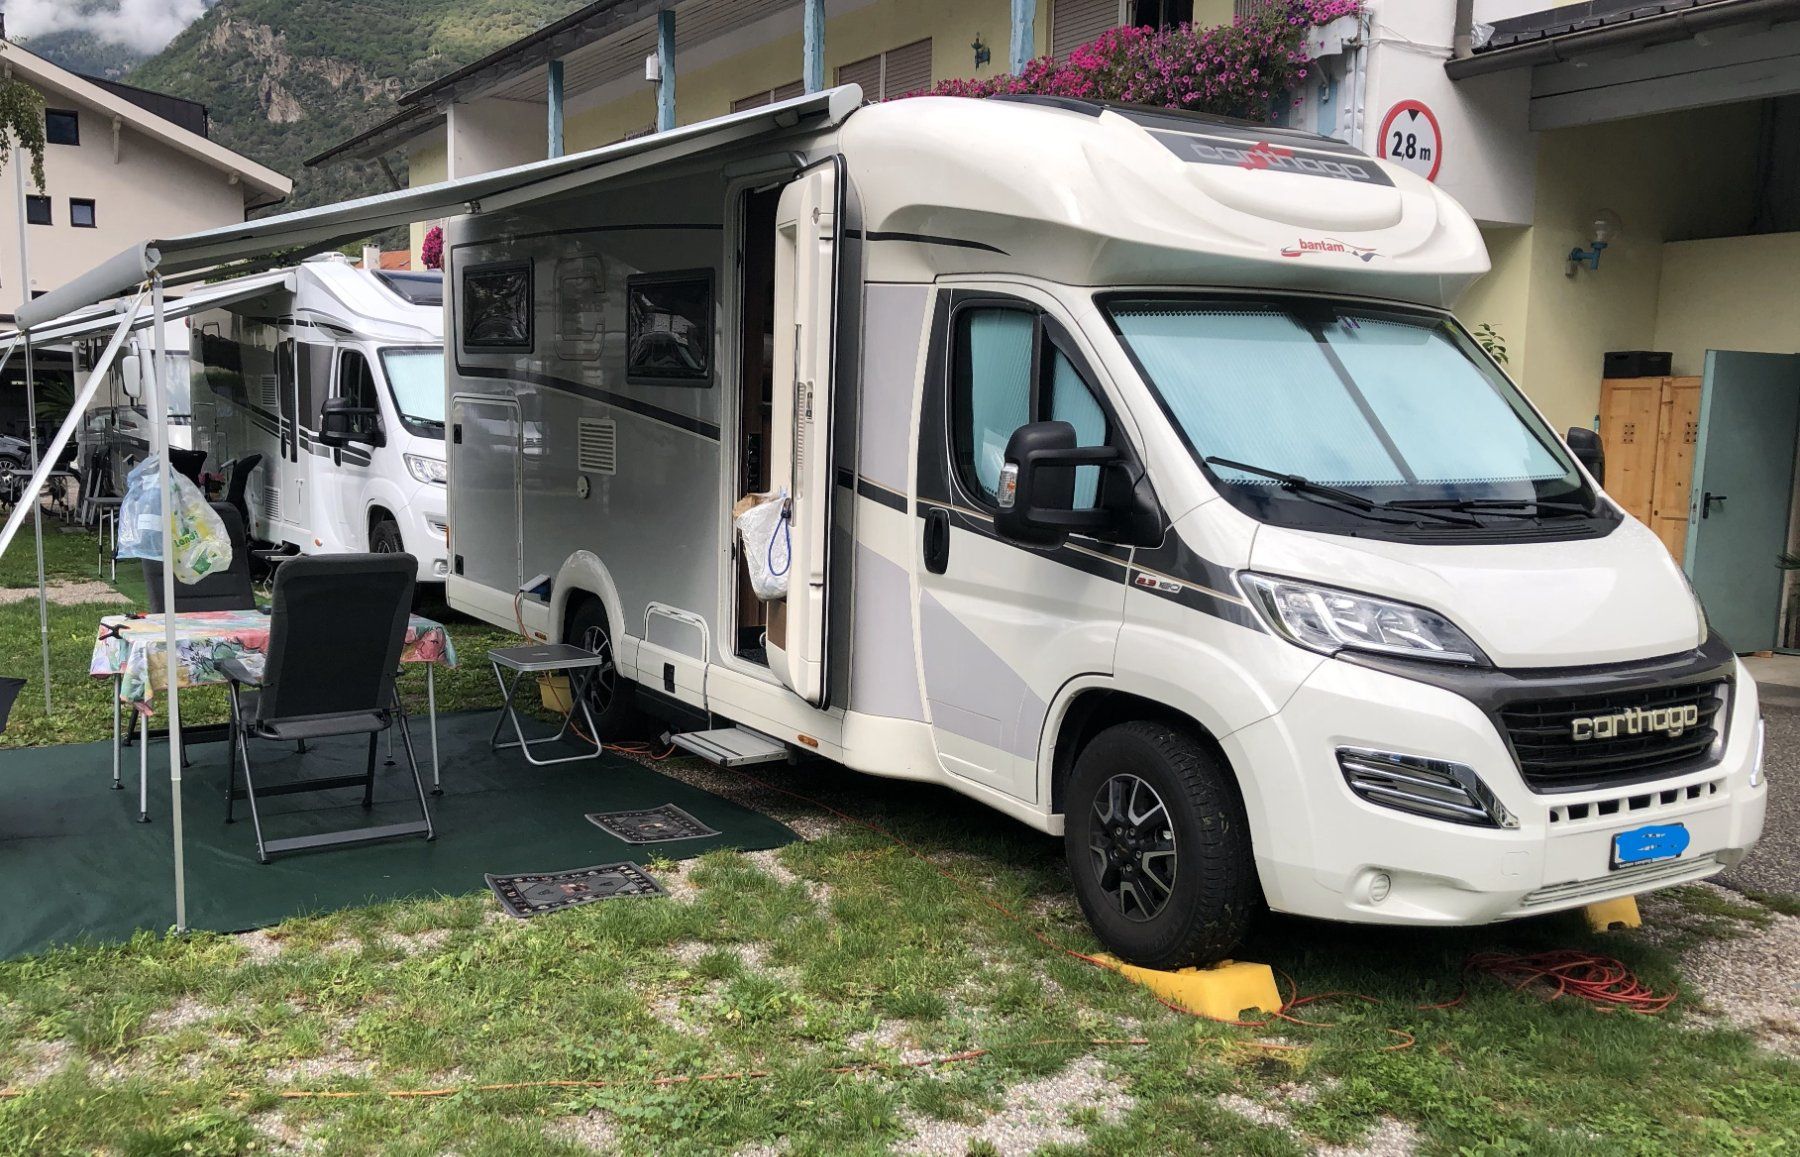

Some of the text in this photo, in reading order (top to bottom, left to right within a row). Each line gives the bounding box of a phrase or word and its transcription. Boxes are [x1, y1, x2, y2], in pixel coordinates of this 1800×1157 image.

[1190, 143, 1370, 181] carthago
[1392, 131, 1431, 161] 2,8 m
[1299, 238, 1345, 252] bantam
[1571, 704, 1698, 741] carthago
